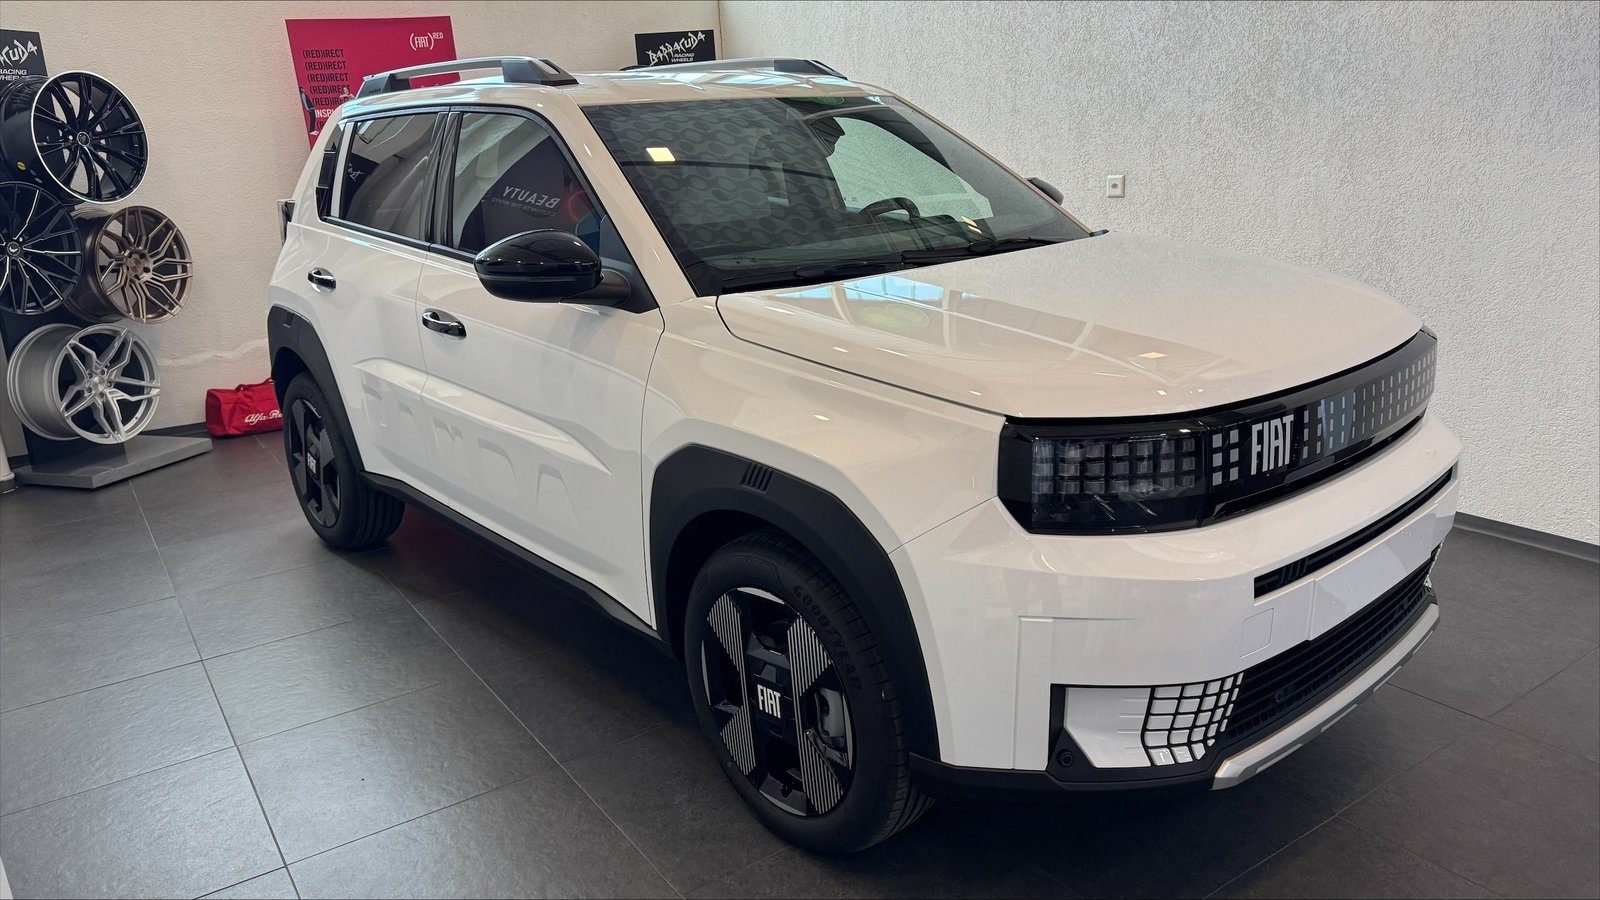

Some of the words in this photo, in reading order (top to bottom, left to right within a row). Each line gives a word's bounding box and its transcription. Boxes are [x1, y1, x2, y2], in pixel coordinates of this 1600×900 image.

[303, 49, 344, 59] (RED)IRECT
[645, 31, 705, 66] BARRACUDA
[305, 61, 346, 71] (RED)IRECT
[307, 72, 349, 83] (RED)IRECT
[1251, 414, 1294, 476] FIAT
[757, 684, 781, 719] FIAT
